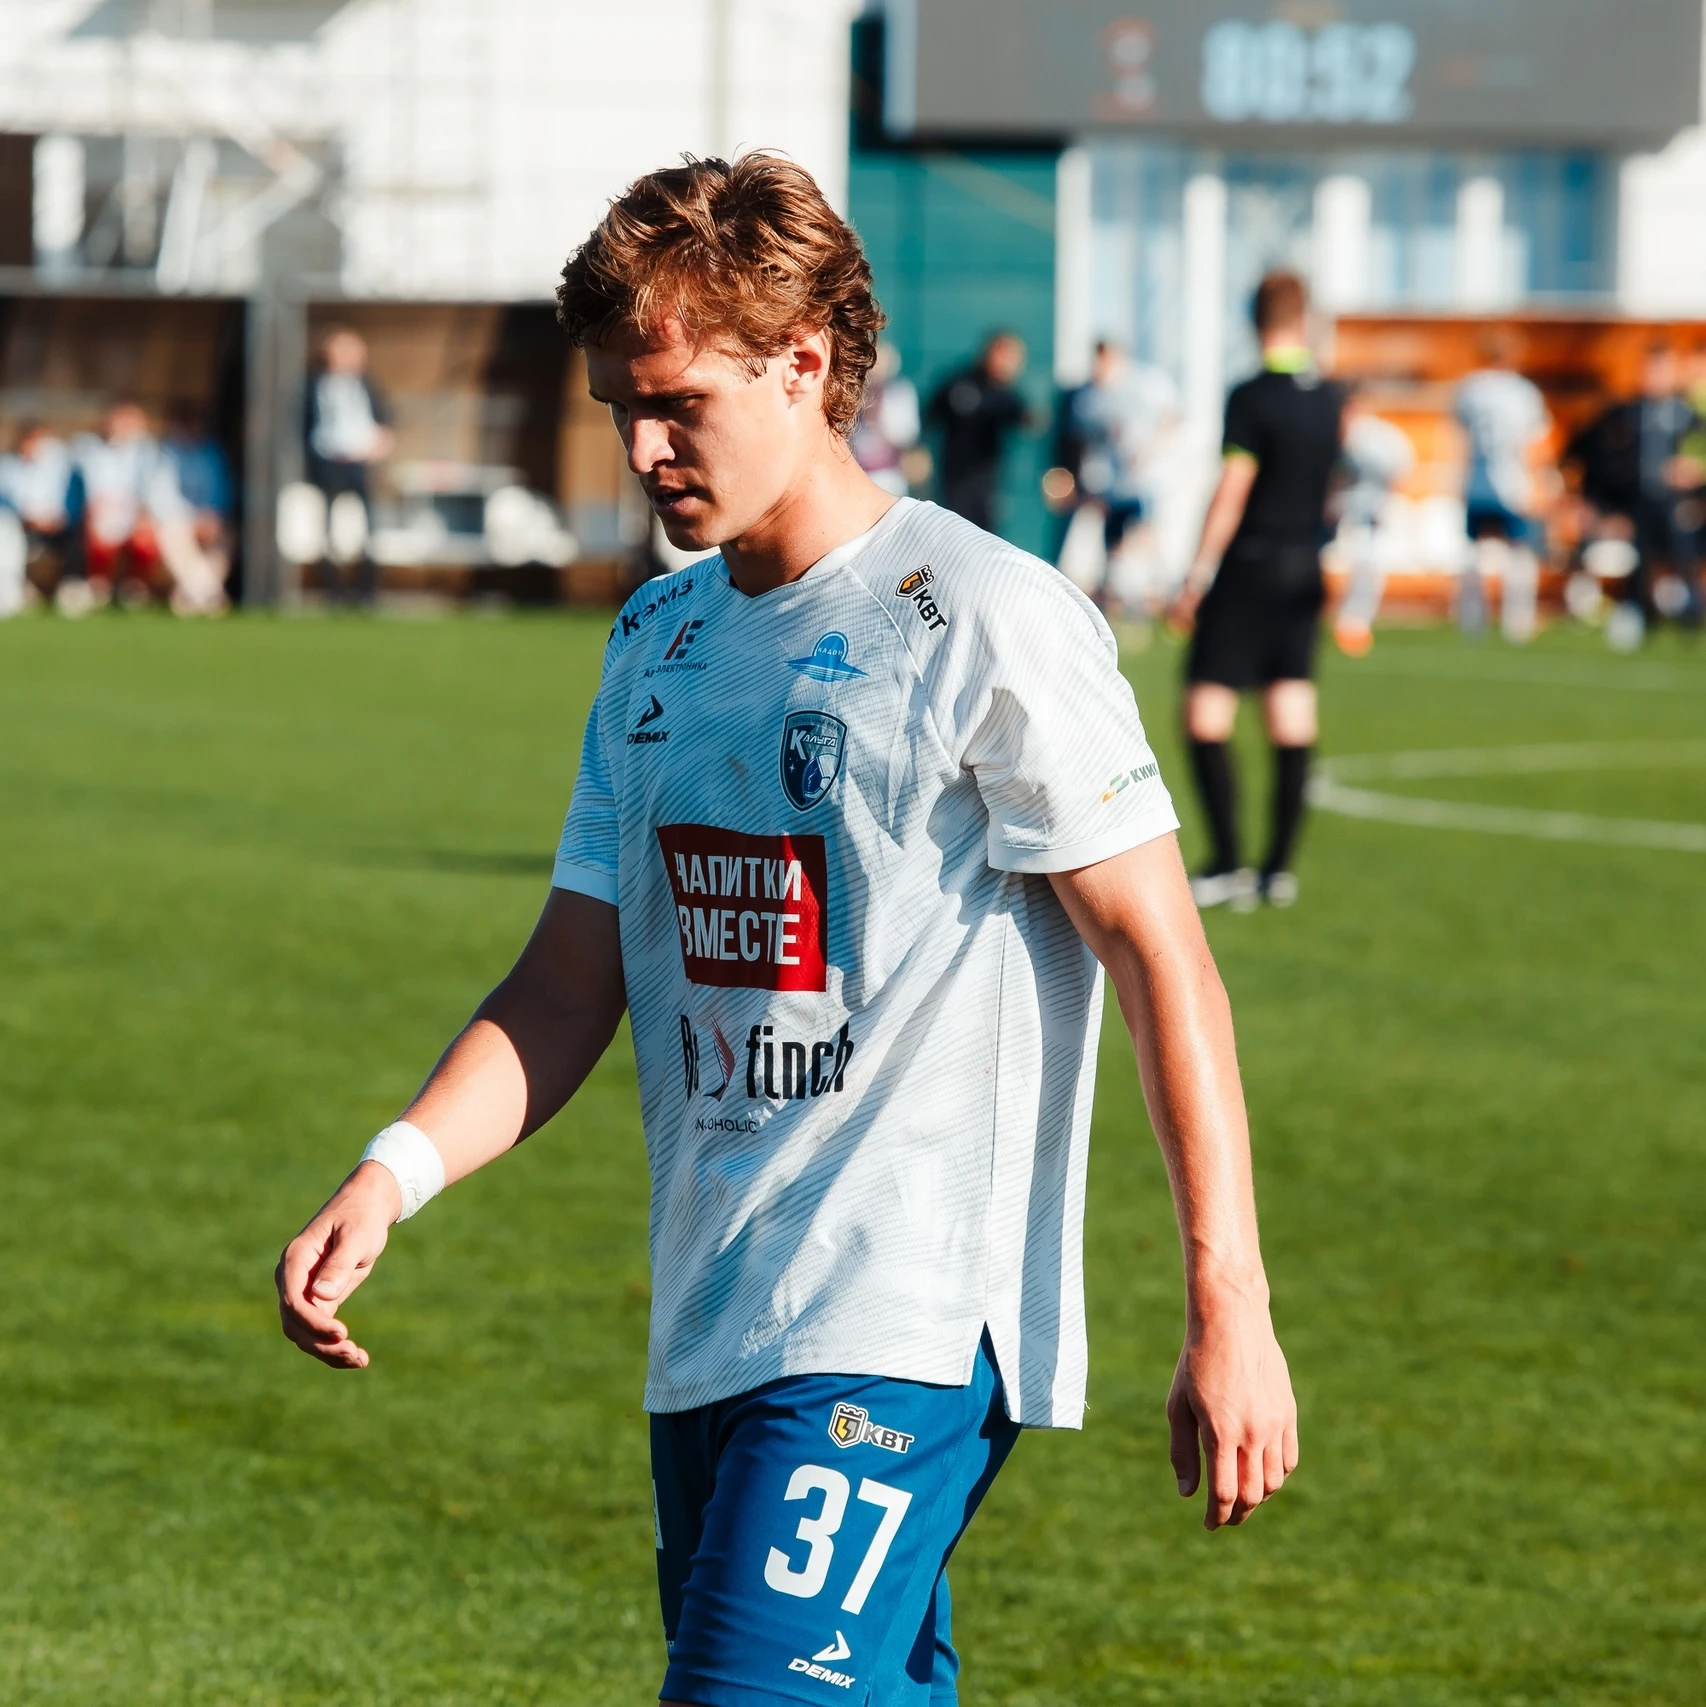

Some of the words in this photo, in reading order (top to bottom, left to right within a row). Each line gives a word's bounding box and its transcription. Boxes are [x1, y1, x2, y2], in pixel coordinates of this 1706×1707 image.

[621, 578, 695, 637] КЭМЗ
[626, 730, 671, 746] DEMIX
[674, 852, 802, 901] НАПИТКИ
[678, 905, 800, 966] ВМЕСТЕ
[745, 1021, 855, 1100] finch
[763, 1463, 914, 1616] 37
[787, 1657, 857, 1690] DEMIX
